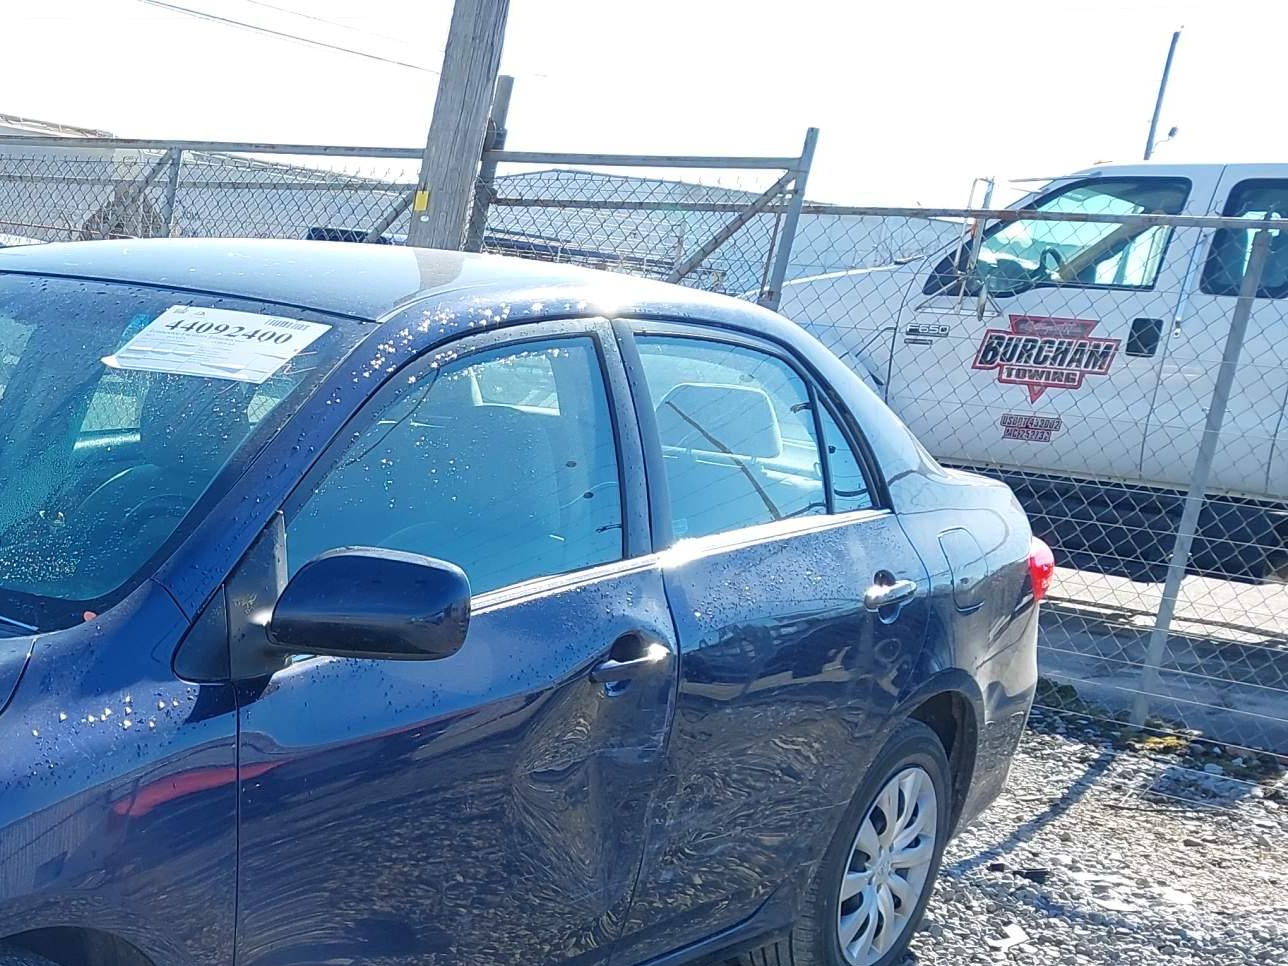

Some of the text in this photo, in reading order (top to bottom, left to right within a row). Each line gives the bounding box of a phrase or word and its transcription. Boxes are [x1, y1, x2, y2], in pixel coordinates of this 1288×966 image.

[165, 319, 293, 344] 44092400
[906, 323, 950, 335] F650
[979, 335, 1115, 369] BURCHAM
[1005, 366, 1078, 384] TOWING
